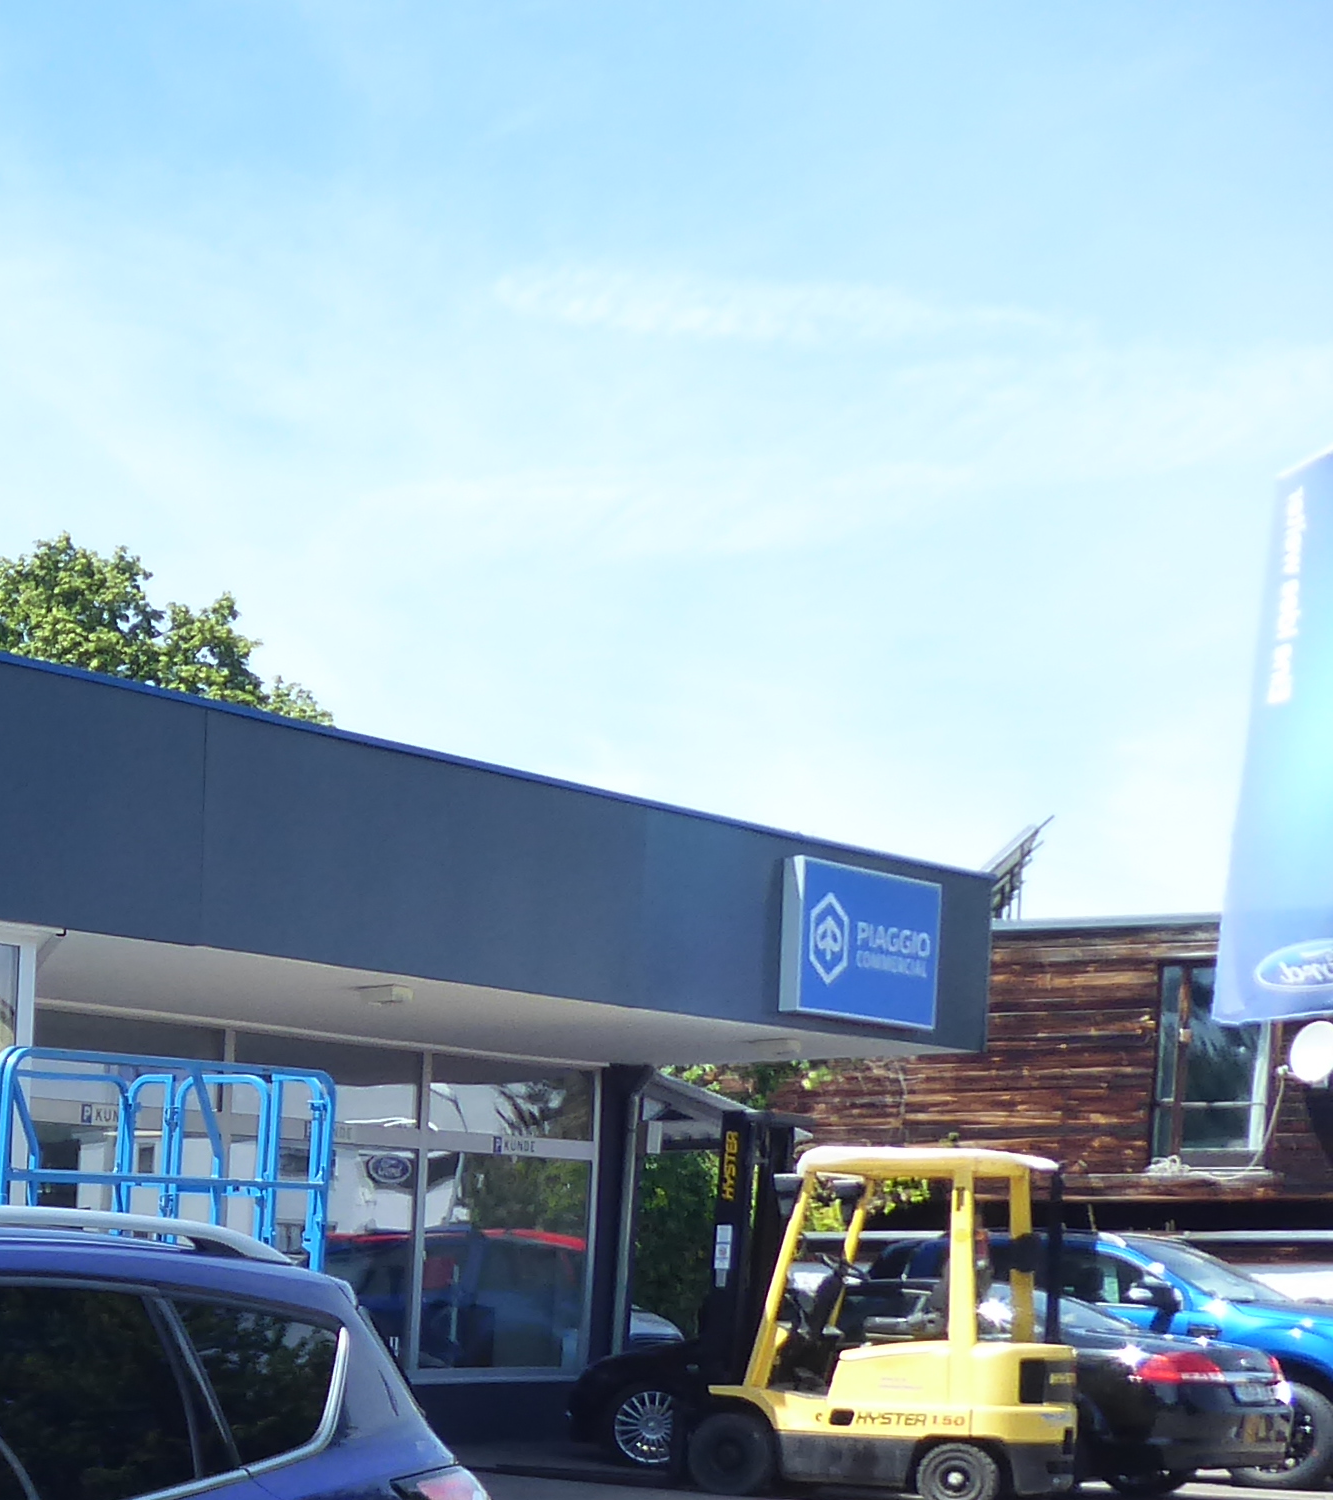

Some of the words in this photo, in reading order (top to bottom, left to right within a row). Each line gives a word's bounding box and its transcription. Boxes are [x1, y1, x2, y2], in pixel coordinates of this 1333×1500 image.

[856, 921, 931, 957] PIAGGIO
[721, 1130, 739, 1201] HYSTER
[855, 1411, 927, 1426] HYSTER
